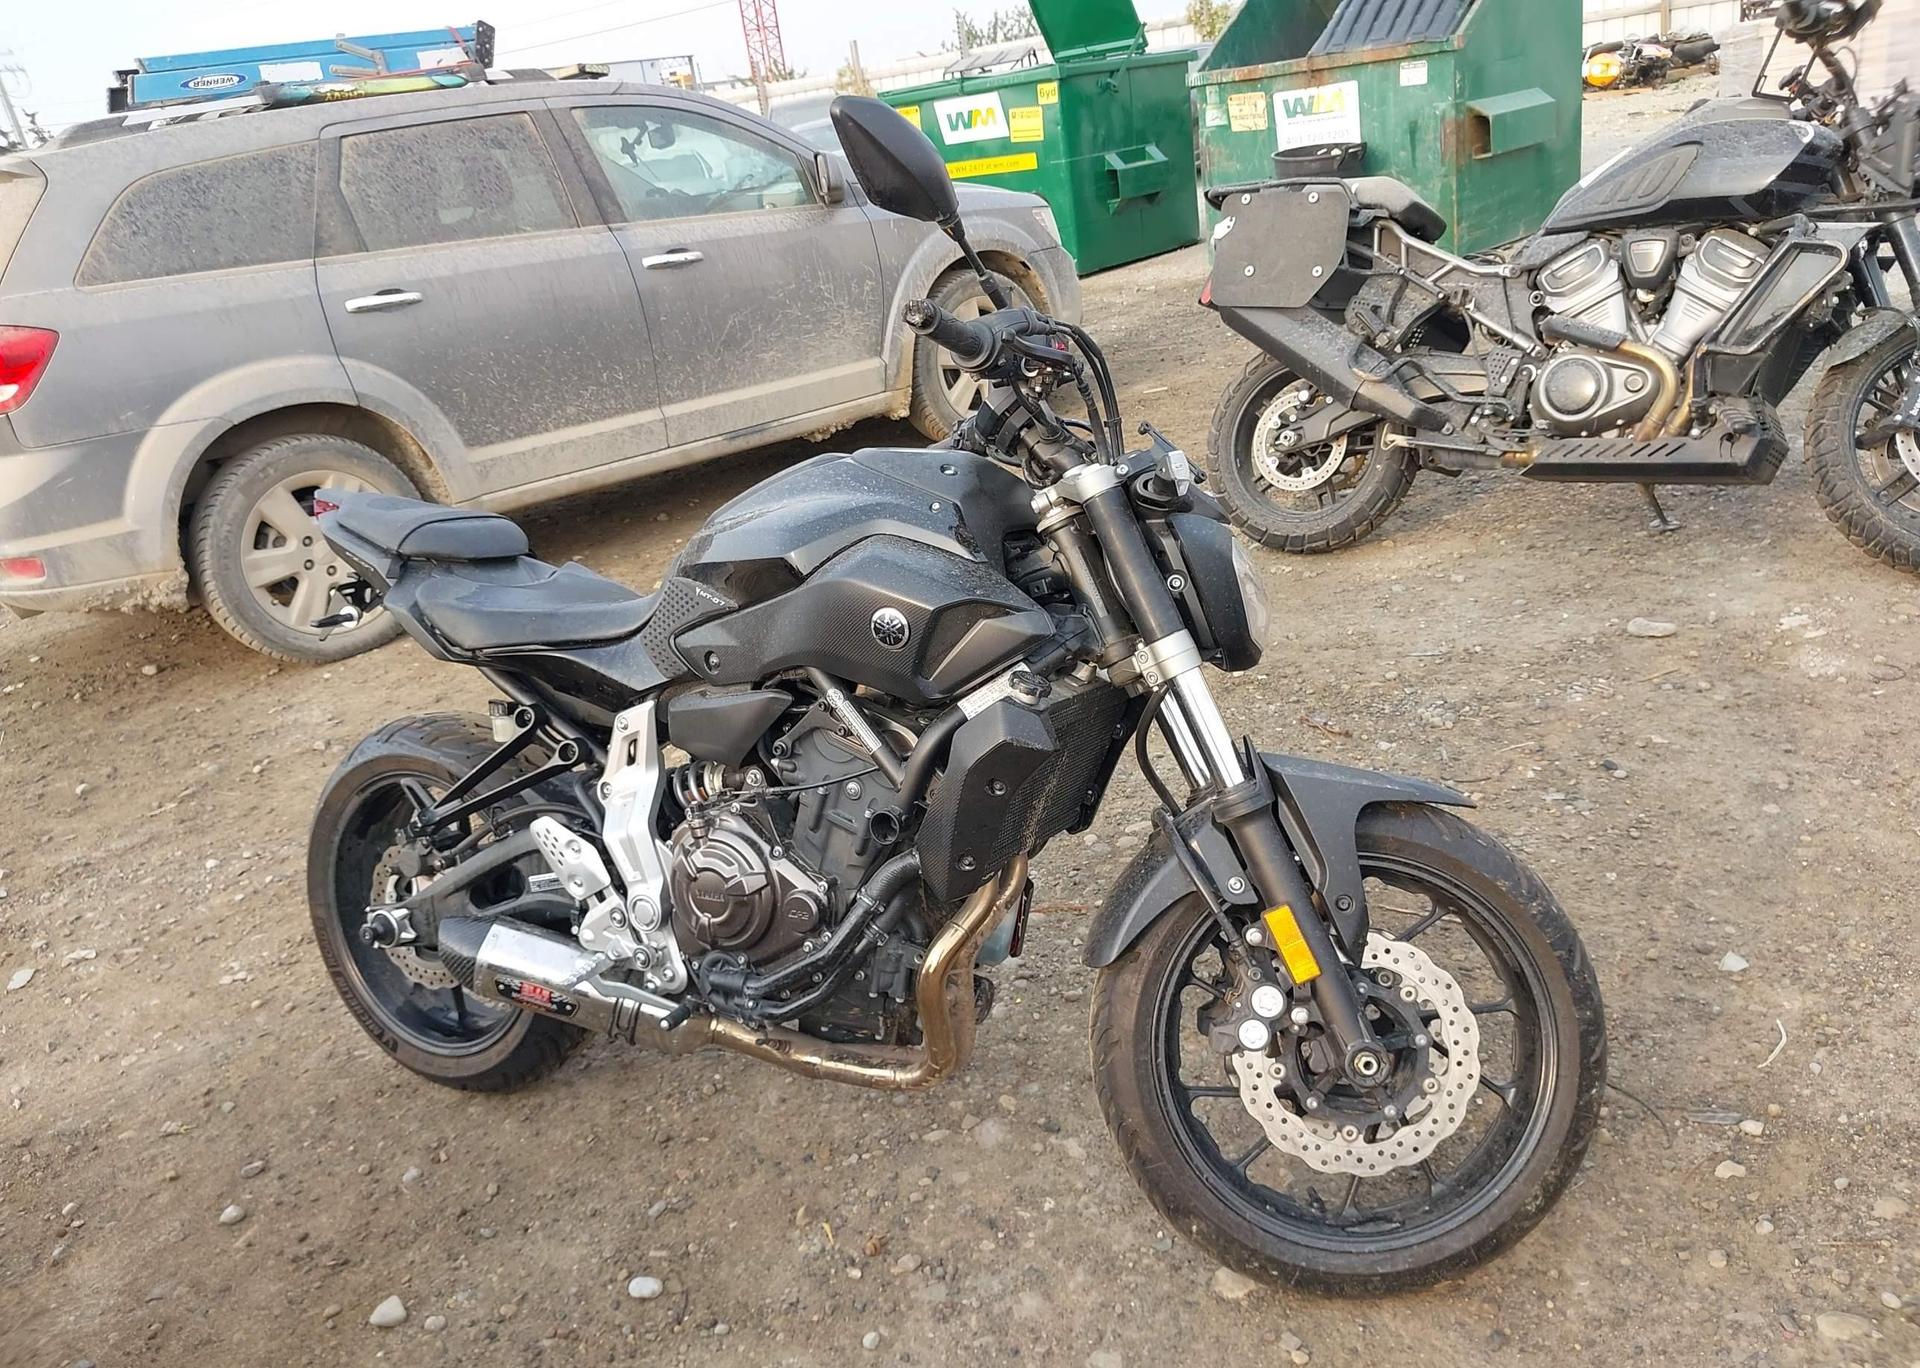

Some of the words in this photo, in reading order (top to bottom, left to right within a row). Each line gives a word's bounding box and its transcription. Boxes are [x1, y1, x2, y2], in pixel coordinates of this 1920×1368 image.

[193, 77, 234, 87] WERNER
[1039, 86, 1057, 100] 6yd
[1282, 90, 1345, 118] WM
[947, 107, 997, 131] WM
[334, 973, 385, 1038] MICHELIN
